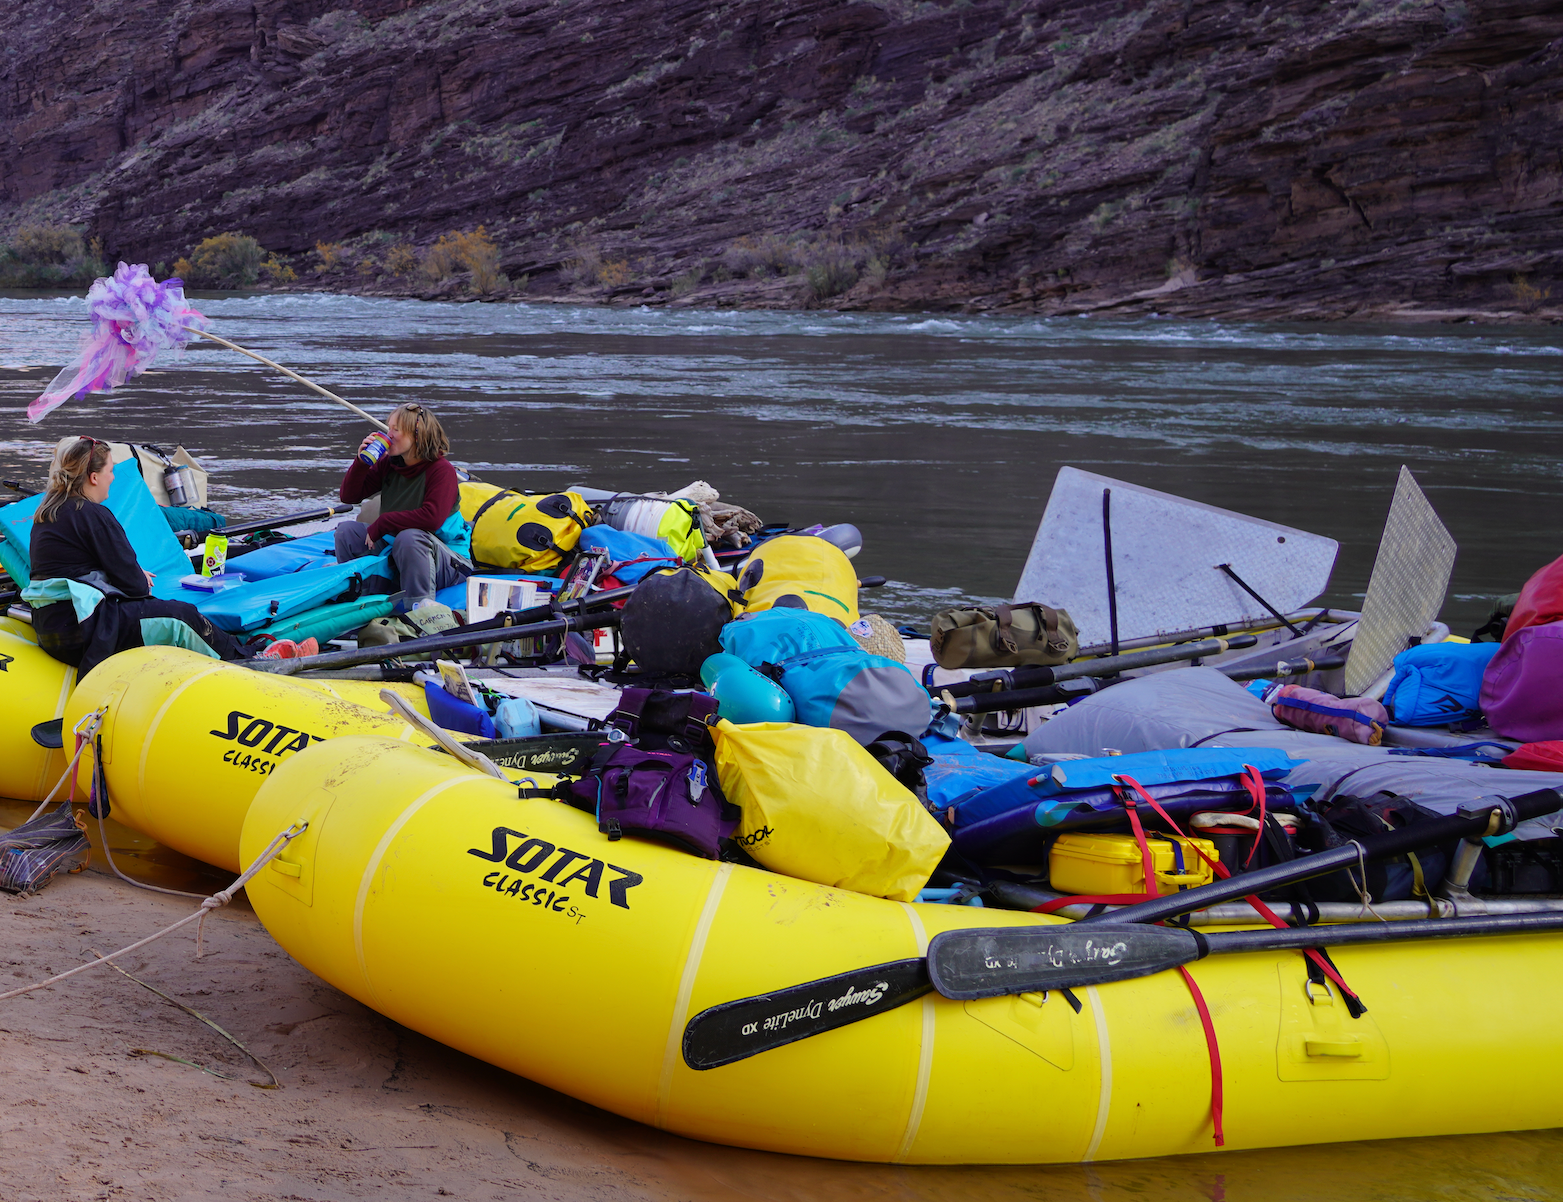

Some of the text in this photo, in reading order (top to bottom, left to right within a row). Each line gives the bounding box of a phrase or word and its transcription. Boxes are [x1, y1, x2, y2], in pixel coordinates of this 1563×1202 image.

[209, 711, 326, 757] SOTA
[223, 750, 276, 776] CLASSI
[467, 826, 644, 909] SOTAR
[482, 871, 587, 925] CLASSIC ST
[763, 999, 824, 1031] DyneLite
[828, 981, 889, 1012] Sawyer
